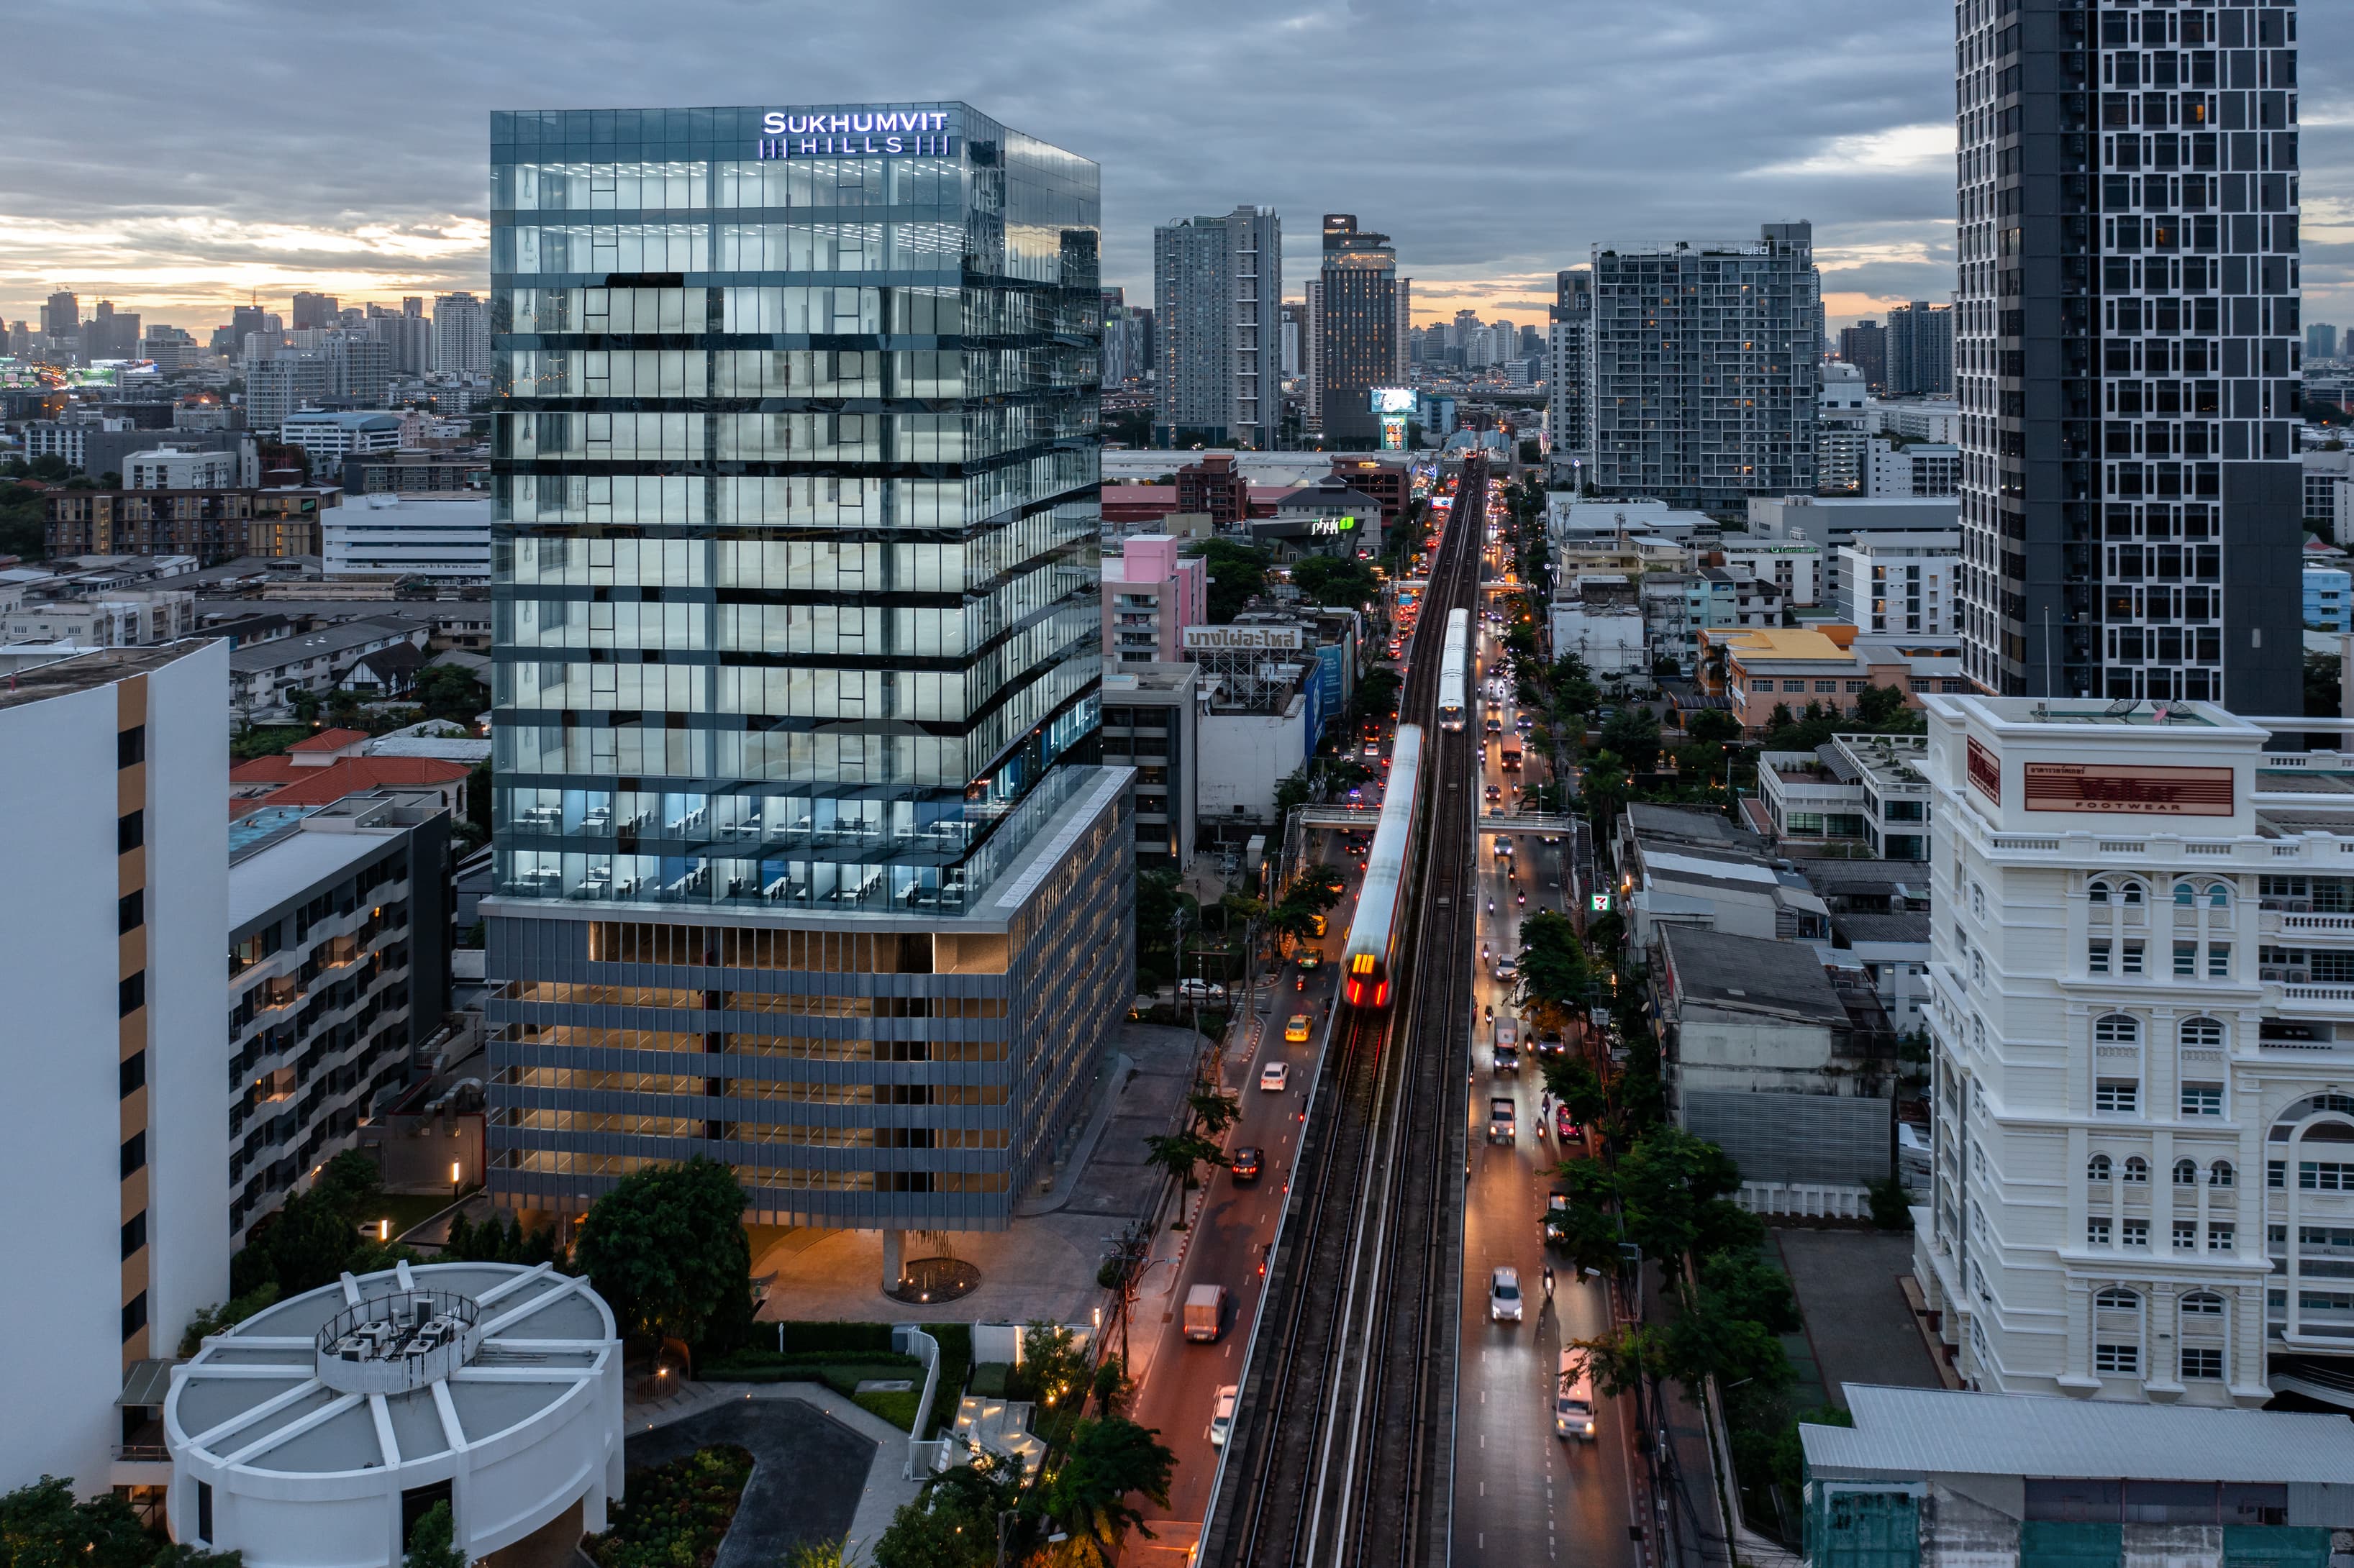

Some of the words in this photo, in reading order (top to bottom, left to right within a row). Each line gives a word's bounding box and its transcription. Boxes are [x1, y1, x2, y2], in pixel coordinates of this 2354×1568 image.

[764, 112, 948, 135] SUKHUMVIT
[801, 137, 904, 154] HILLS
[2076, 777, 2183, 801] Walker
[2076, 801, 2181, 811] FOOTWEAR
